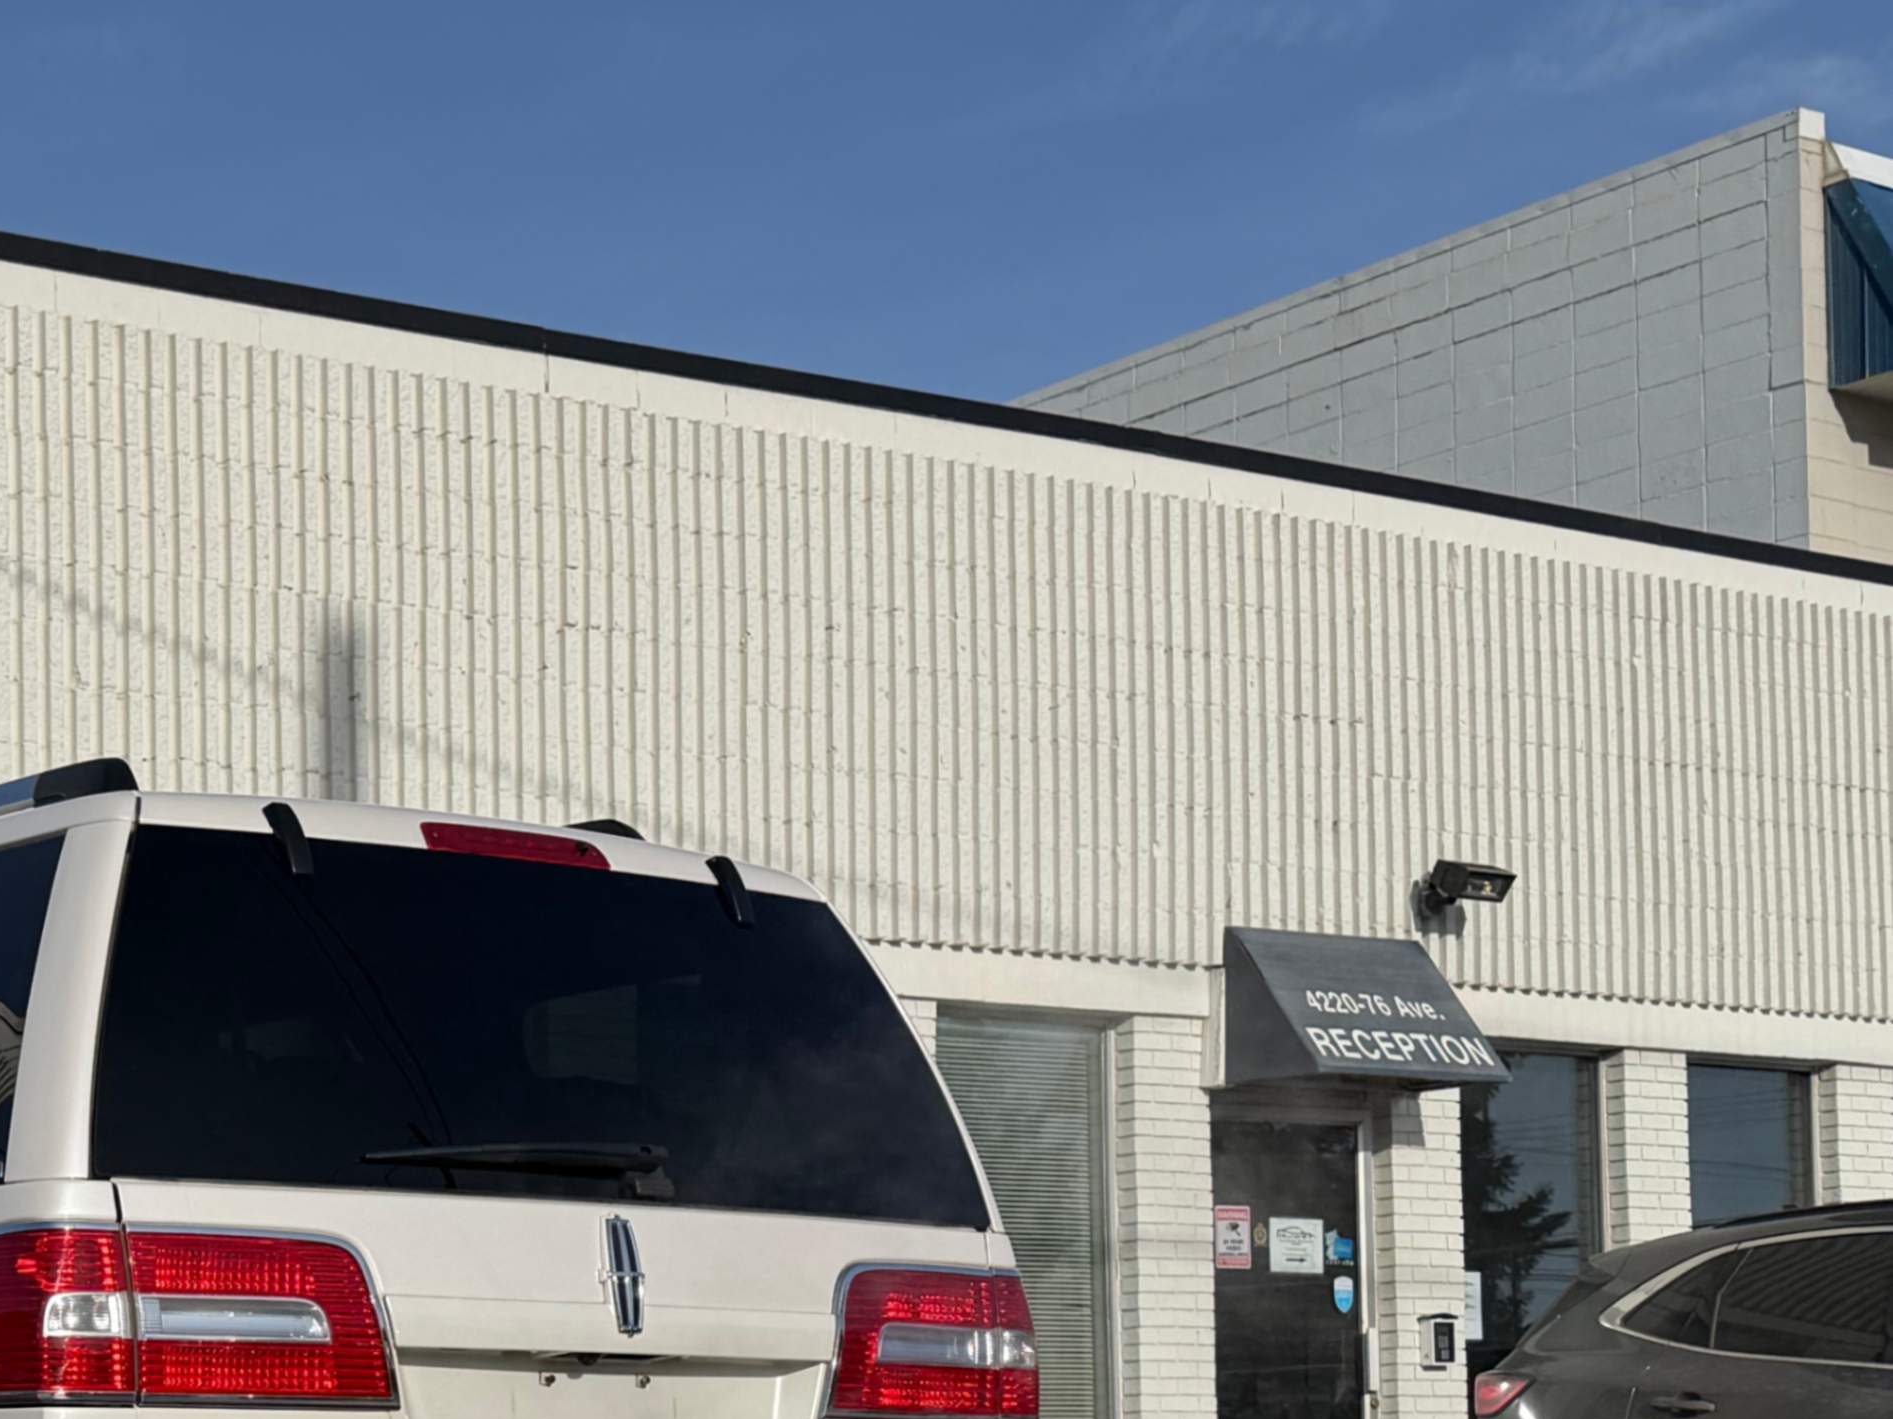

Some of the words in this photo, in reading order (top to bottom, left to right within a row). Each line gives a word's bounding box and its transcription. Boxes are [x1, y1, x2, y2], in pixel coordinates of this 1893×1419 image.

[1306, 990, 1392, 1017] 4220-76
[1393, 995, 1447, 1021] Ave.
[1305, 1026, 1496, 1067] RECEPTION
